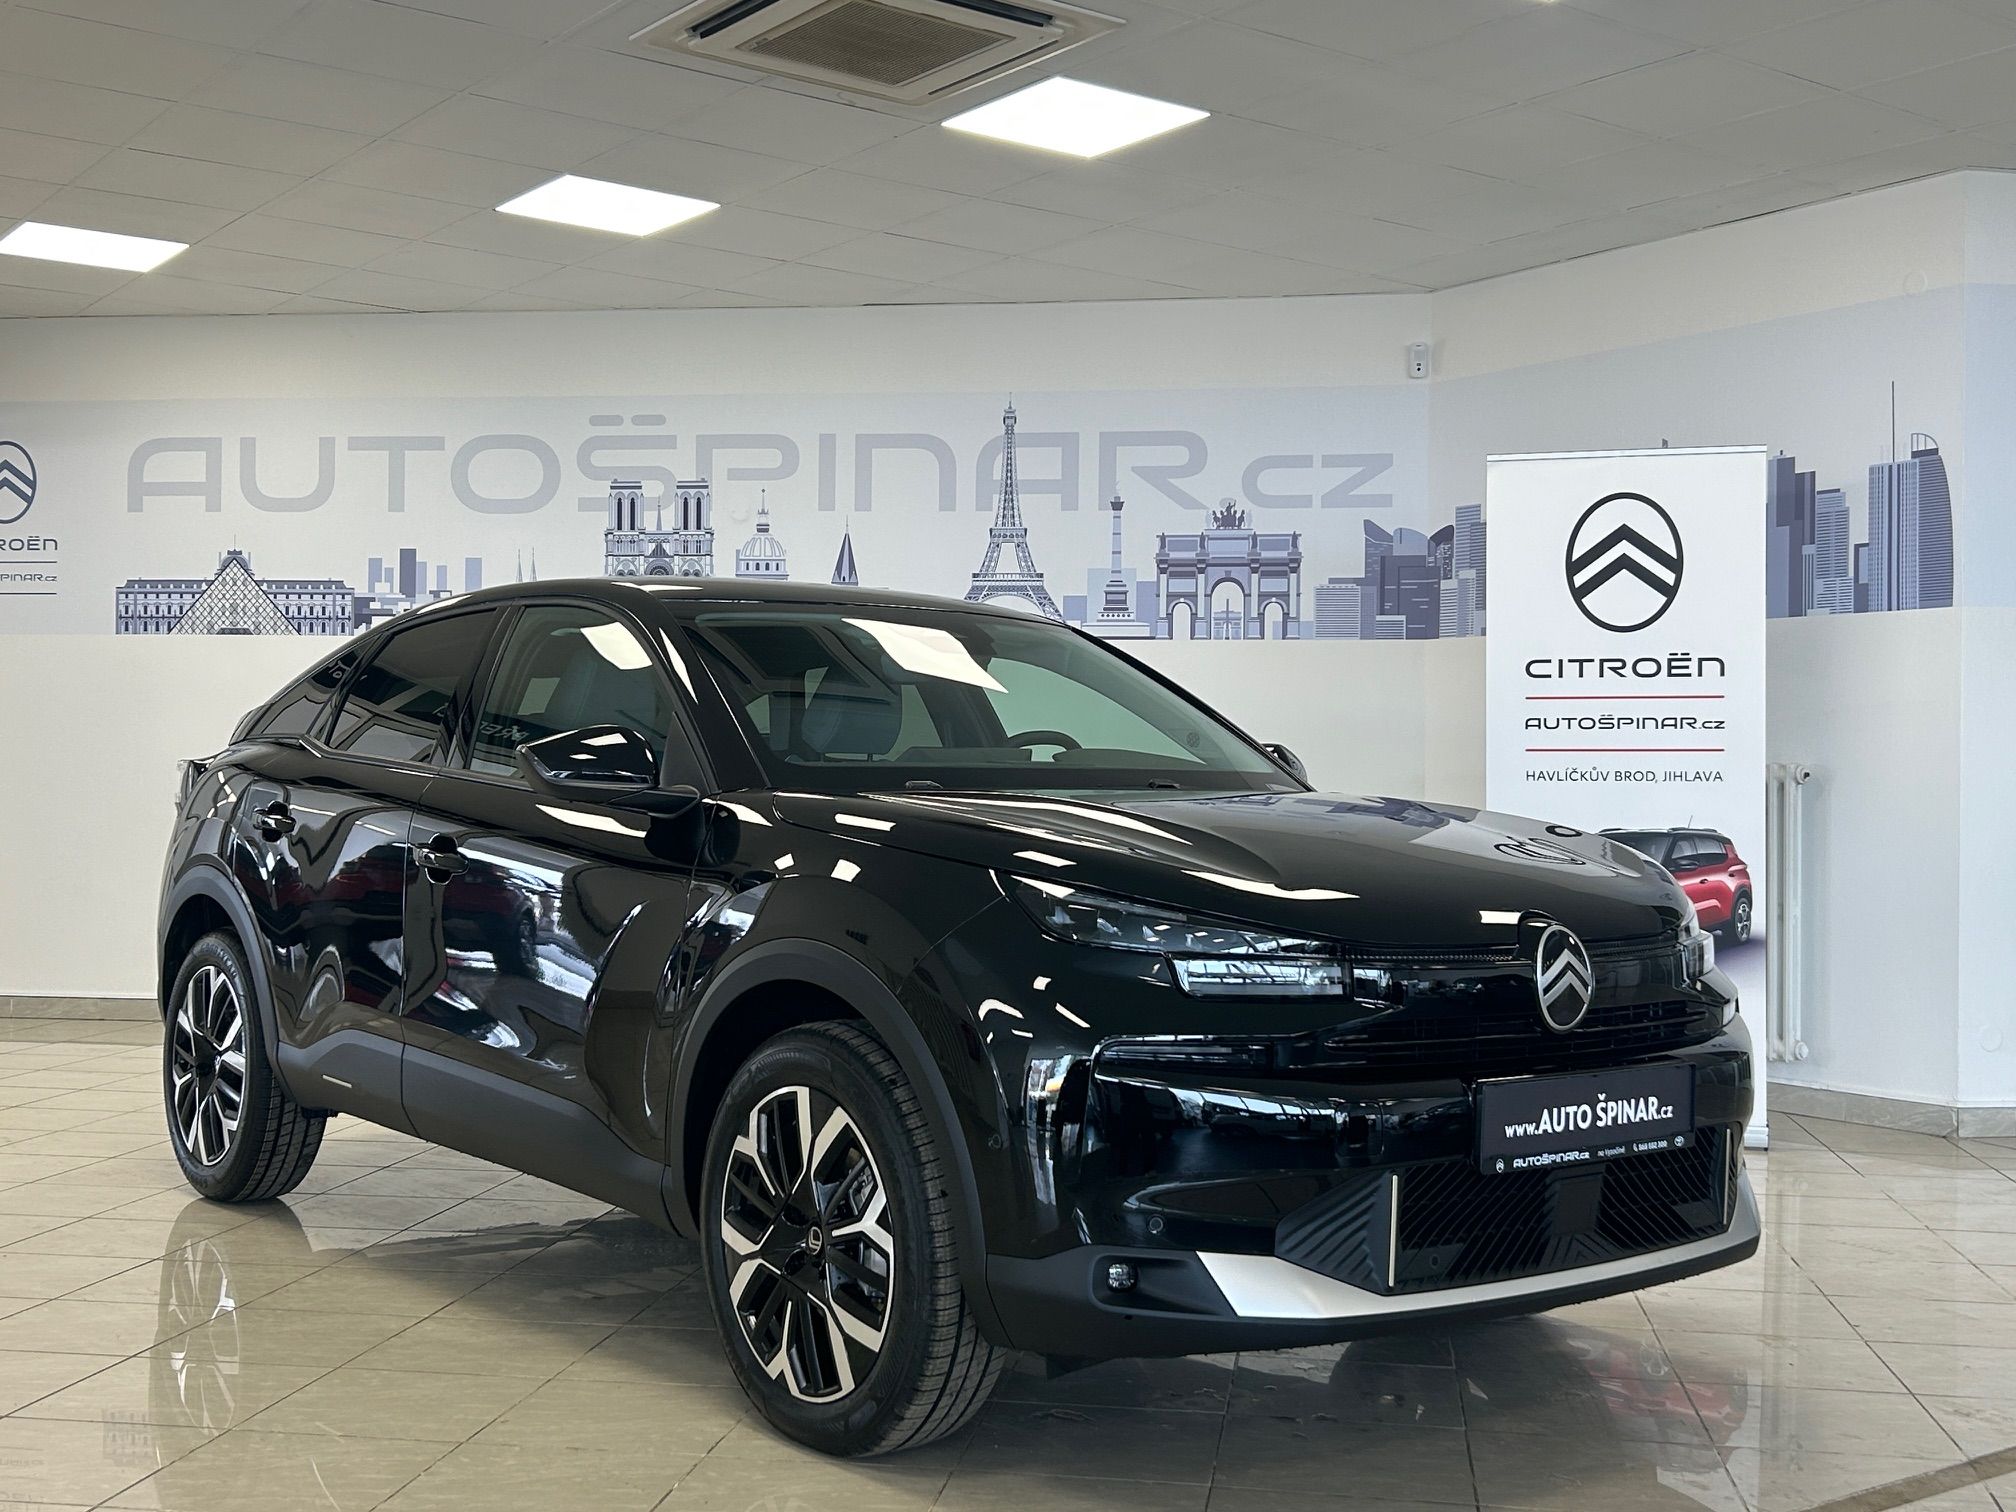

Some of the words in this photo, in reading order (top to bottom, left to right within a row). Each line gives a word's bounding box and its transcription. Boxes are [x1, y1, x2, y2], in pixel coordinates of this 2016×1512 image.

[1525, 652, 1725, 678] CITROËN
[1526, 766, 1610, 782] HAVLÍČKŮV
[1614, 770, 1658, 783] BROD,
[1662, 770, 1723, 782] JIHLAVA
[1505, 1104, 1592, 1138] www.AUTO
[1596, 1093, 1673, 1128] ŠPINAR.cz
